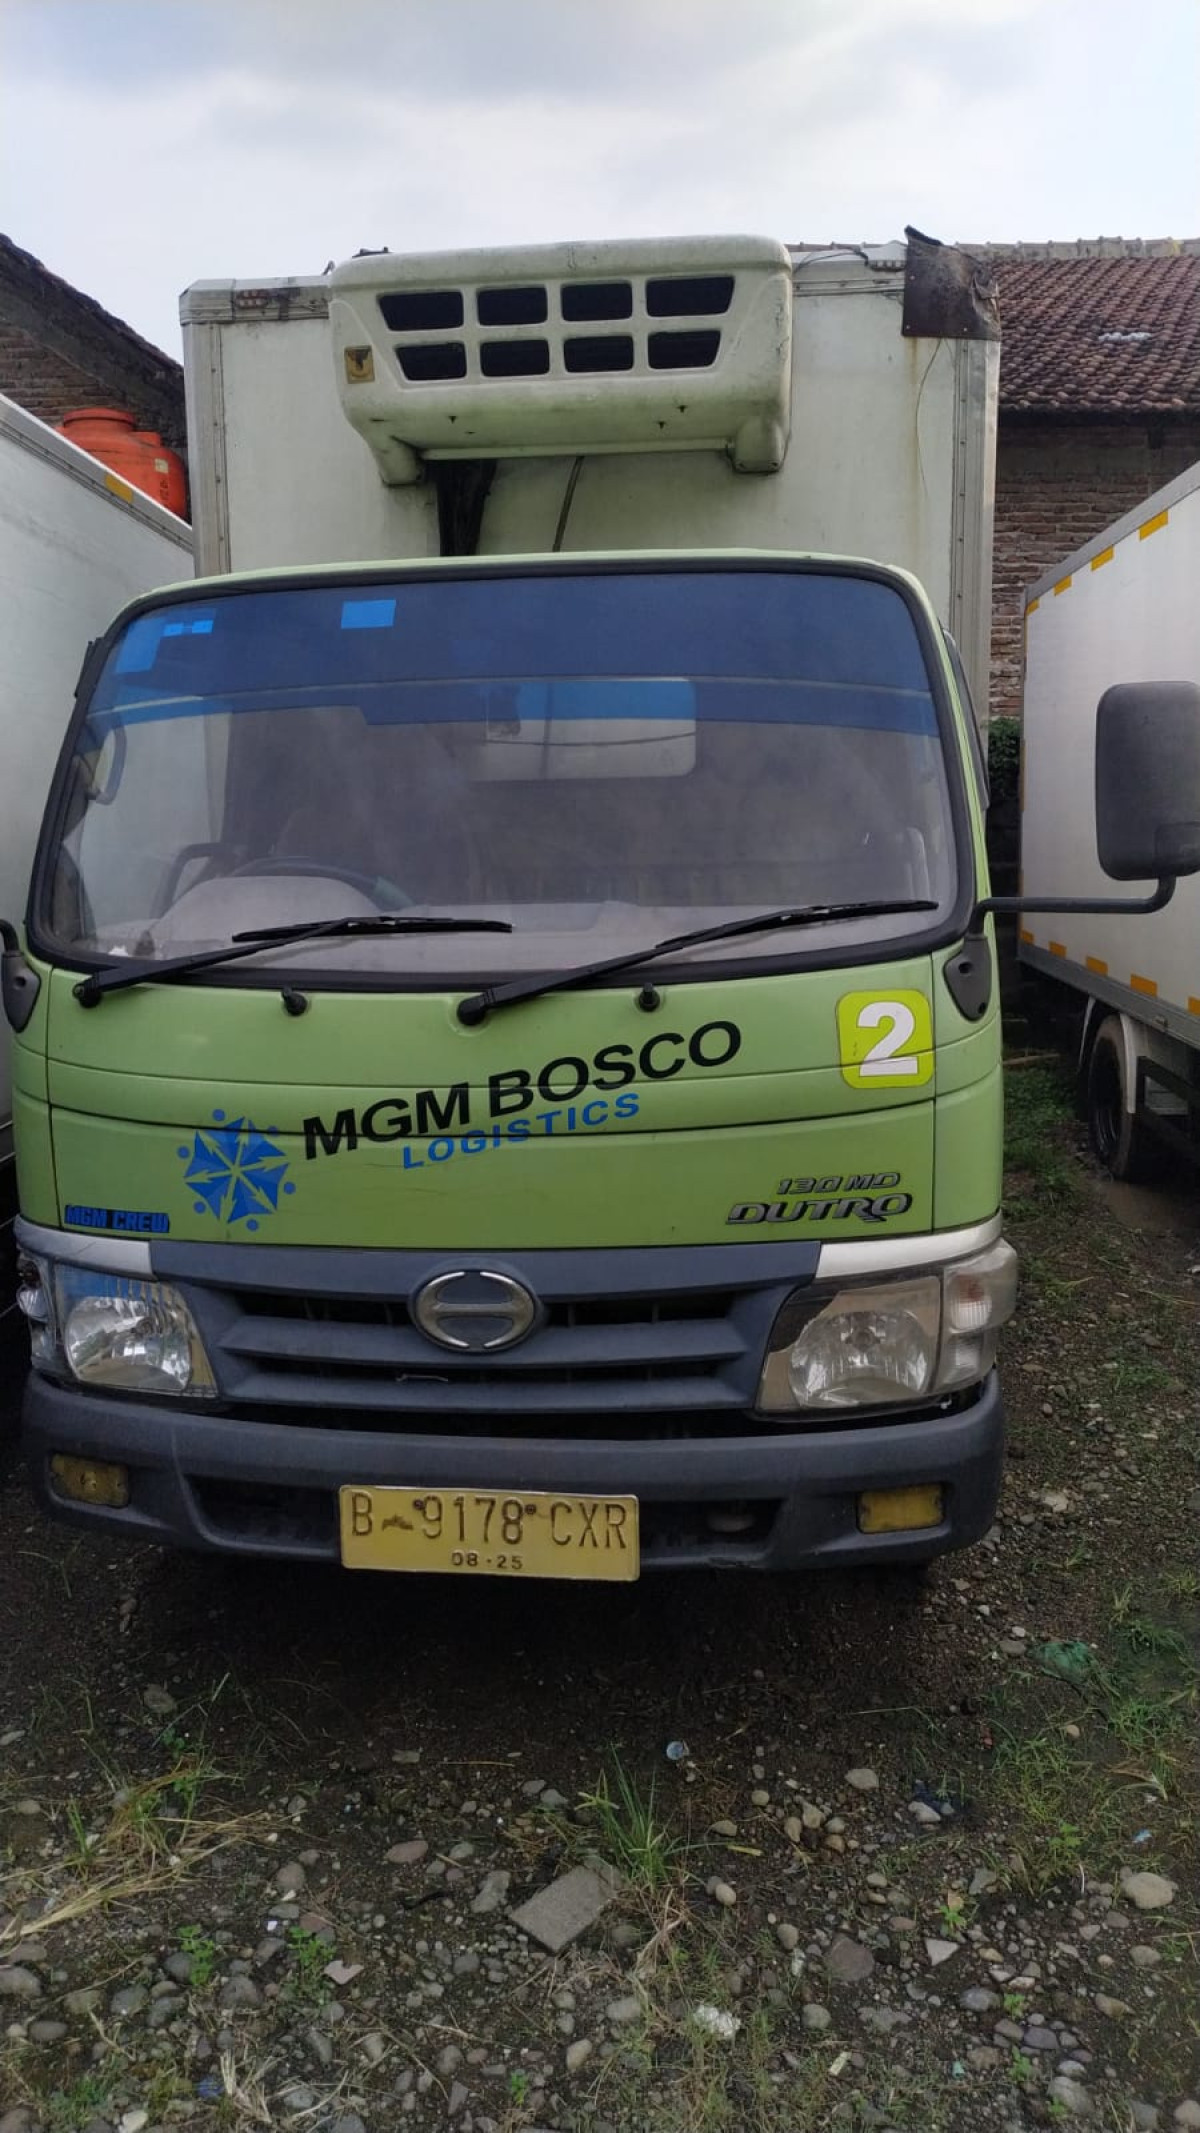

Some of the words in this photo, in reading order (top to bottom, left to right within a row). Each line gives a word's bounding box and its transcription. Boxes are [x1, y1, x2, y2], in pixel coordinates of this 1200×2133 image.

[856, 1001, 919, 1077] 2
[303, 1082, 472, 1160] MGM
[488, 1020, 742, 1118] BOSCO
[403, 1093, 641, 1169] LOGISTICS
[726, 1193, 913, 1225] DUTRO
[777, 1176, 843, 1195] 130
[843, 1172, 901, 1191] MD
[66, 1206, 107, 1228] MGM
[112, 1211, 168, 1232] CREW
[351, 1492, 373, 1537] B
[422, 1494, 524, 1545] 9178
[550, 1500, 628, 1550] CXR
